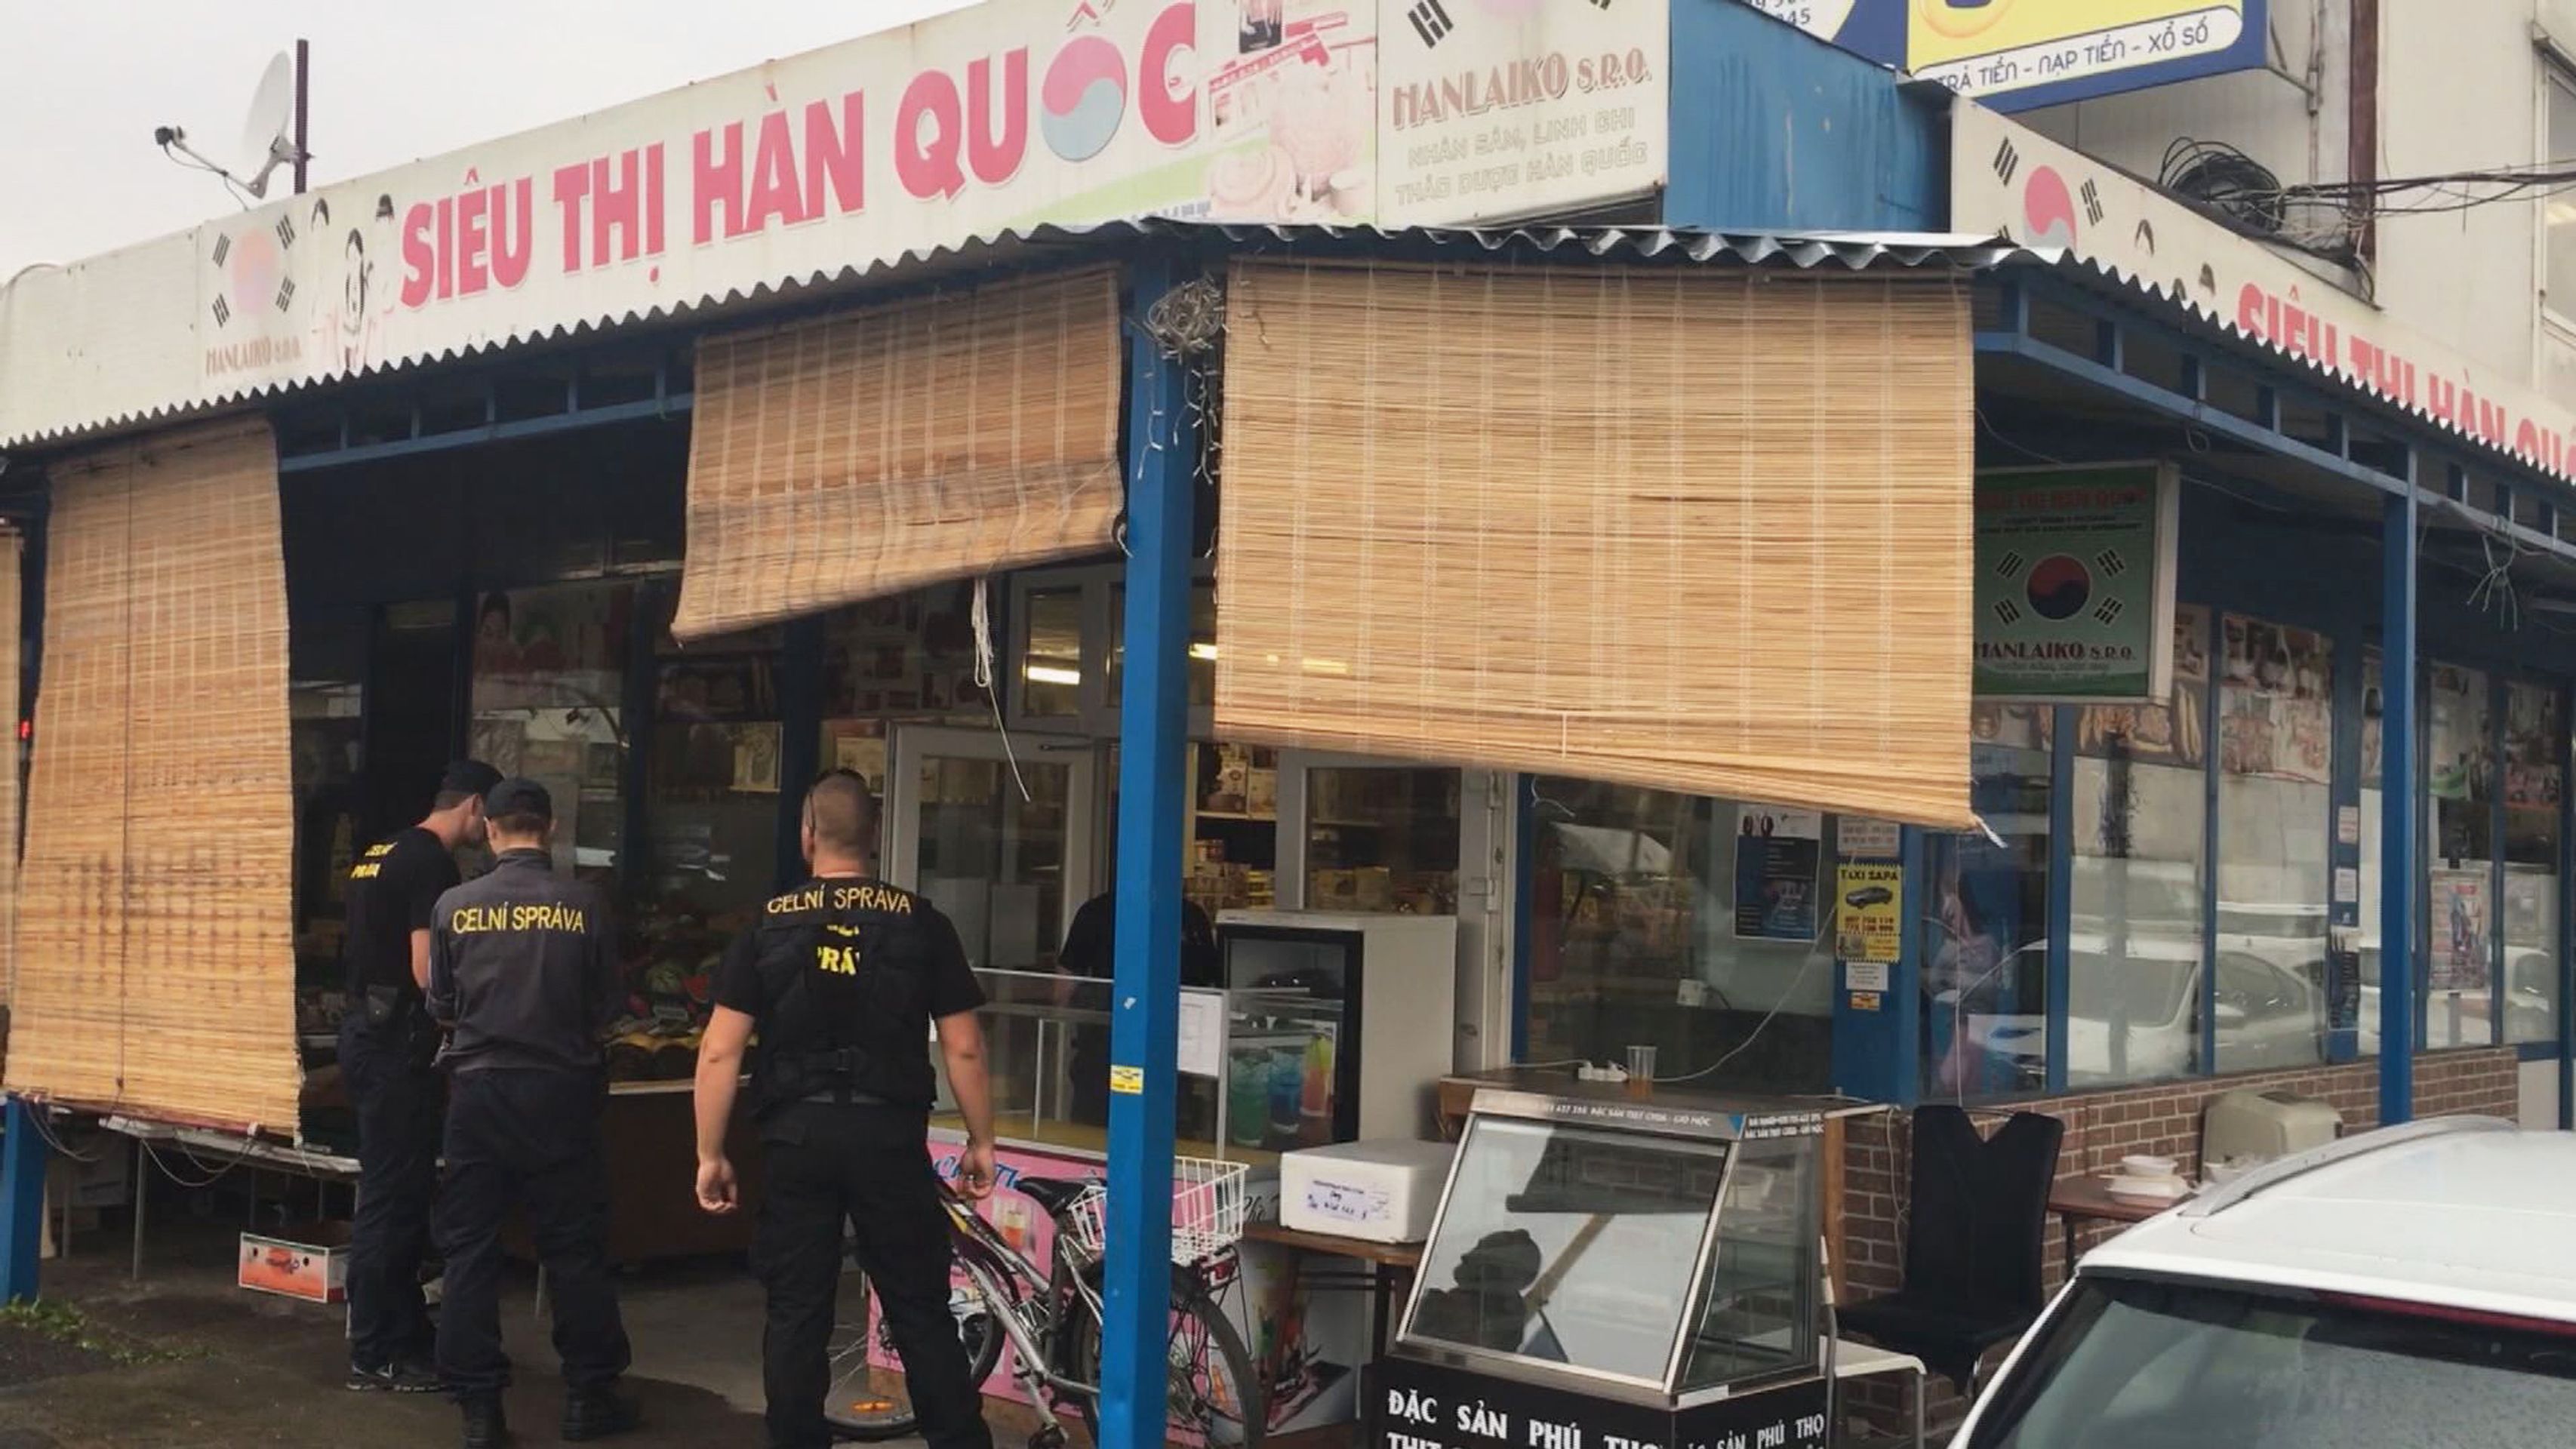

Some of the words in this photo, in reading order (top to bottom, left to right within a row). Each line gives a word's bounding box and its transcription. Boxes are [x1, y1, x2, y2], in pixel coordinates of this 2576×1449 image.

[1393, 51, 1568, 131] HANLAIKO
[401, 168, 533, 309] SIÊU
[554, 141, 665, 284] THỊ
[693, 78, 865, 245] HÀN
[453, 901, 508, 934] CELNÍ
[512, 901, 586, 934] SPRÁVA
[833, 884, 912, 914] SPRÁVA
[1389, 1389, 1437, 1425] ĐẶC
[1457, 1399, 1508, 1439] SẢN
[1529, 1422, 1581, 1449] PHÚ
